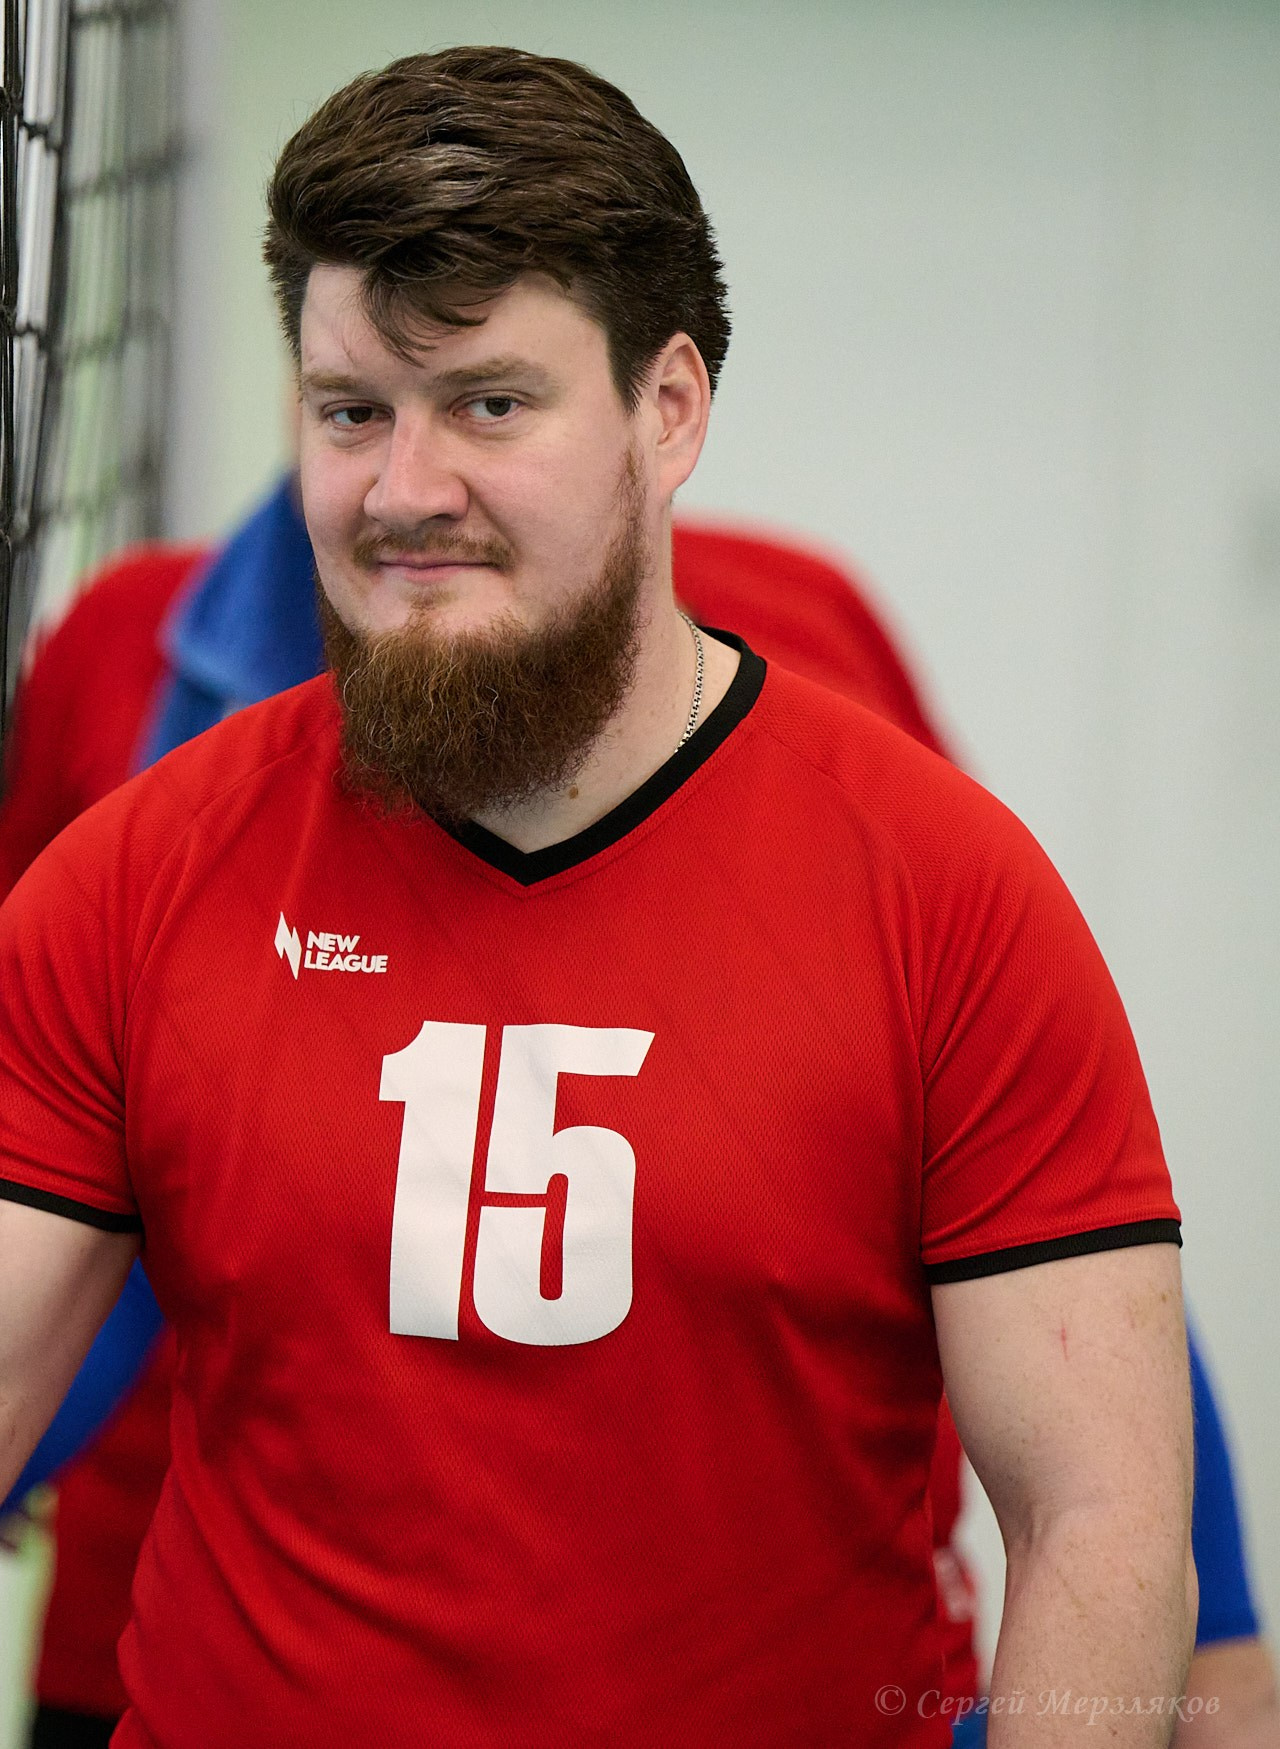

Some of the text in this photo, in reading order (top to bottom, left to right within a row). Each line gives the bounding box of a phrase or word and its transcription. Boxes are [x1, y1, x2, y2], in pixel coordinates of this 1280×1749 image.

[306, 930, 360, 952] NEW
[304, 950, 388, 973] LEAGUE
[378, 1020, 656, 1346] 15
